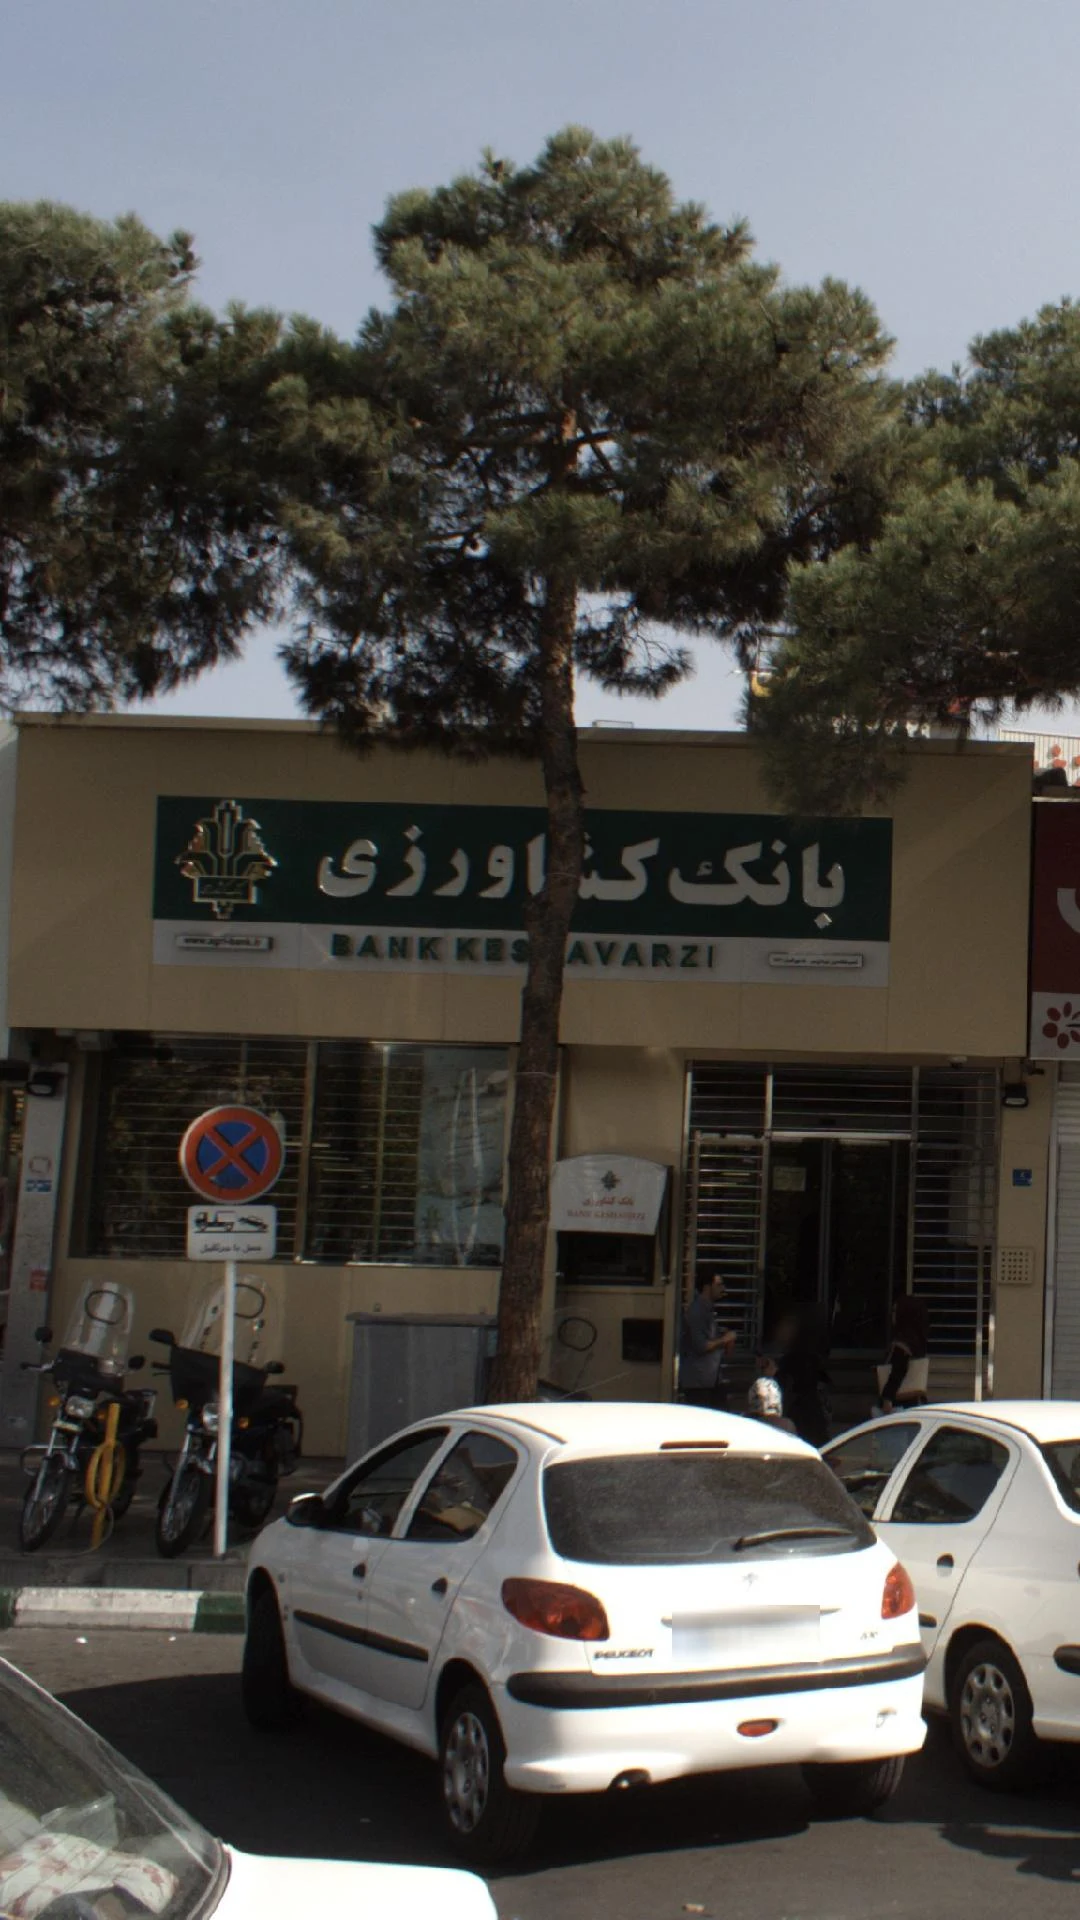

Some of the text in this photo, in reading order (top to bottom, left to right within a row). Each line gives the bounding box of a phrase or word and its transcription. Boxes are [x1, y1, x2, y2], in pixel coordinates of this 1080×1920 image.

[668, 838, 845, 929] بانک
[331, 934, 714, 968] BANK KESAVARZI
